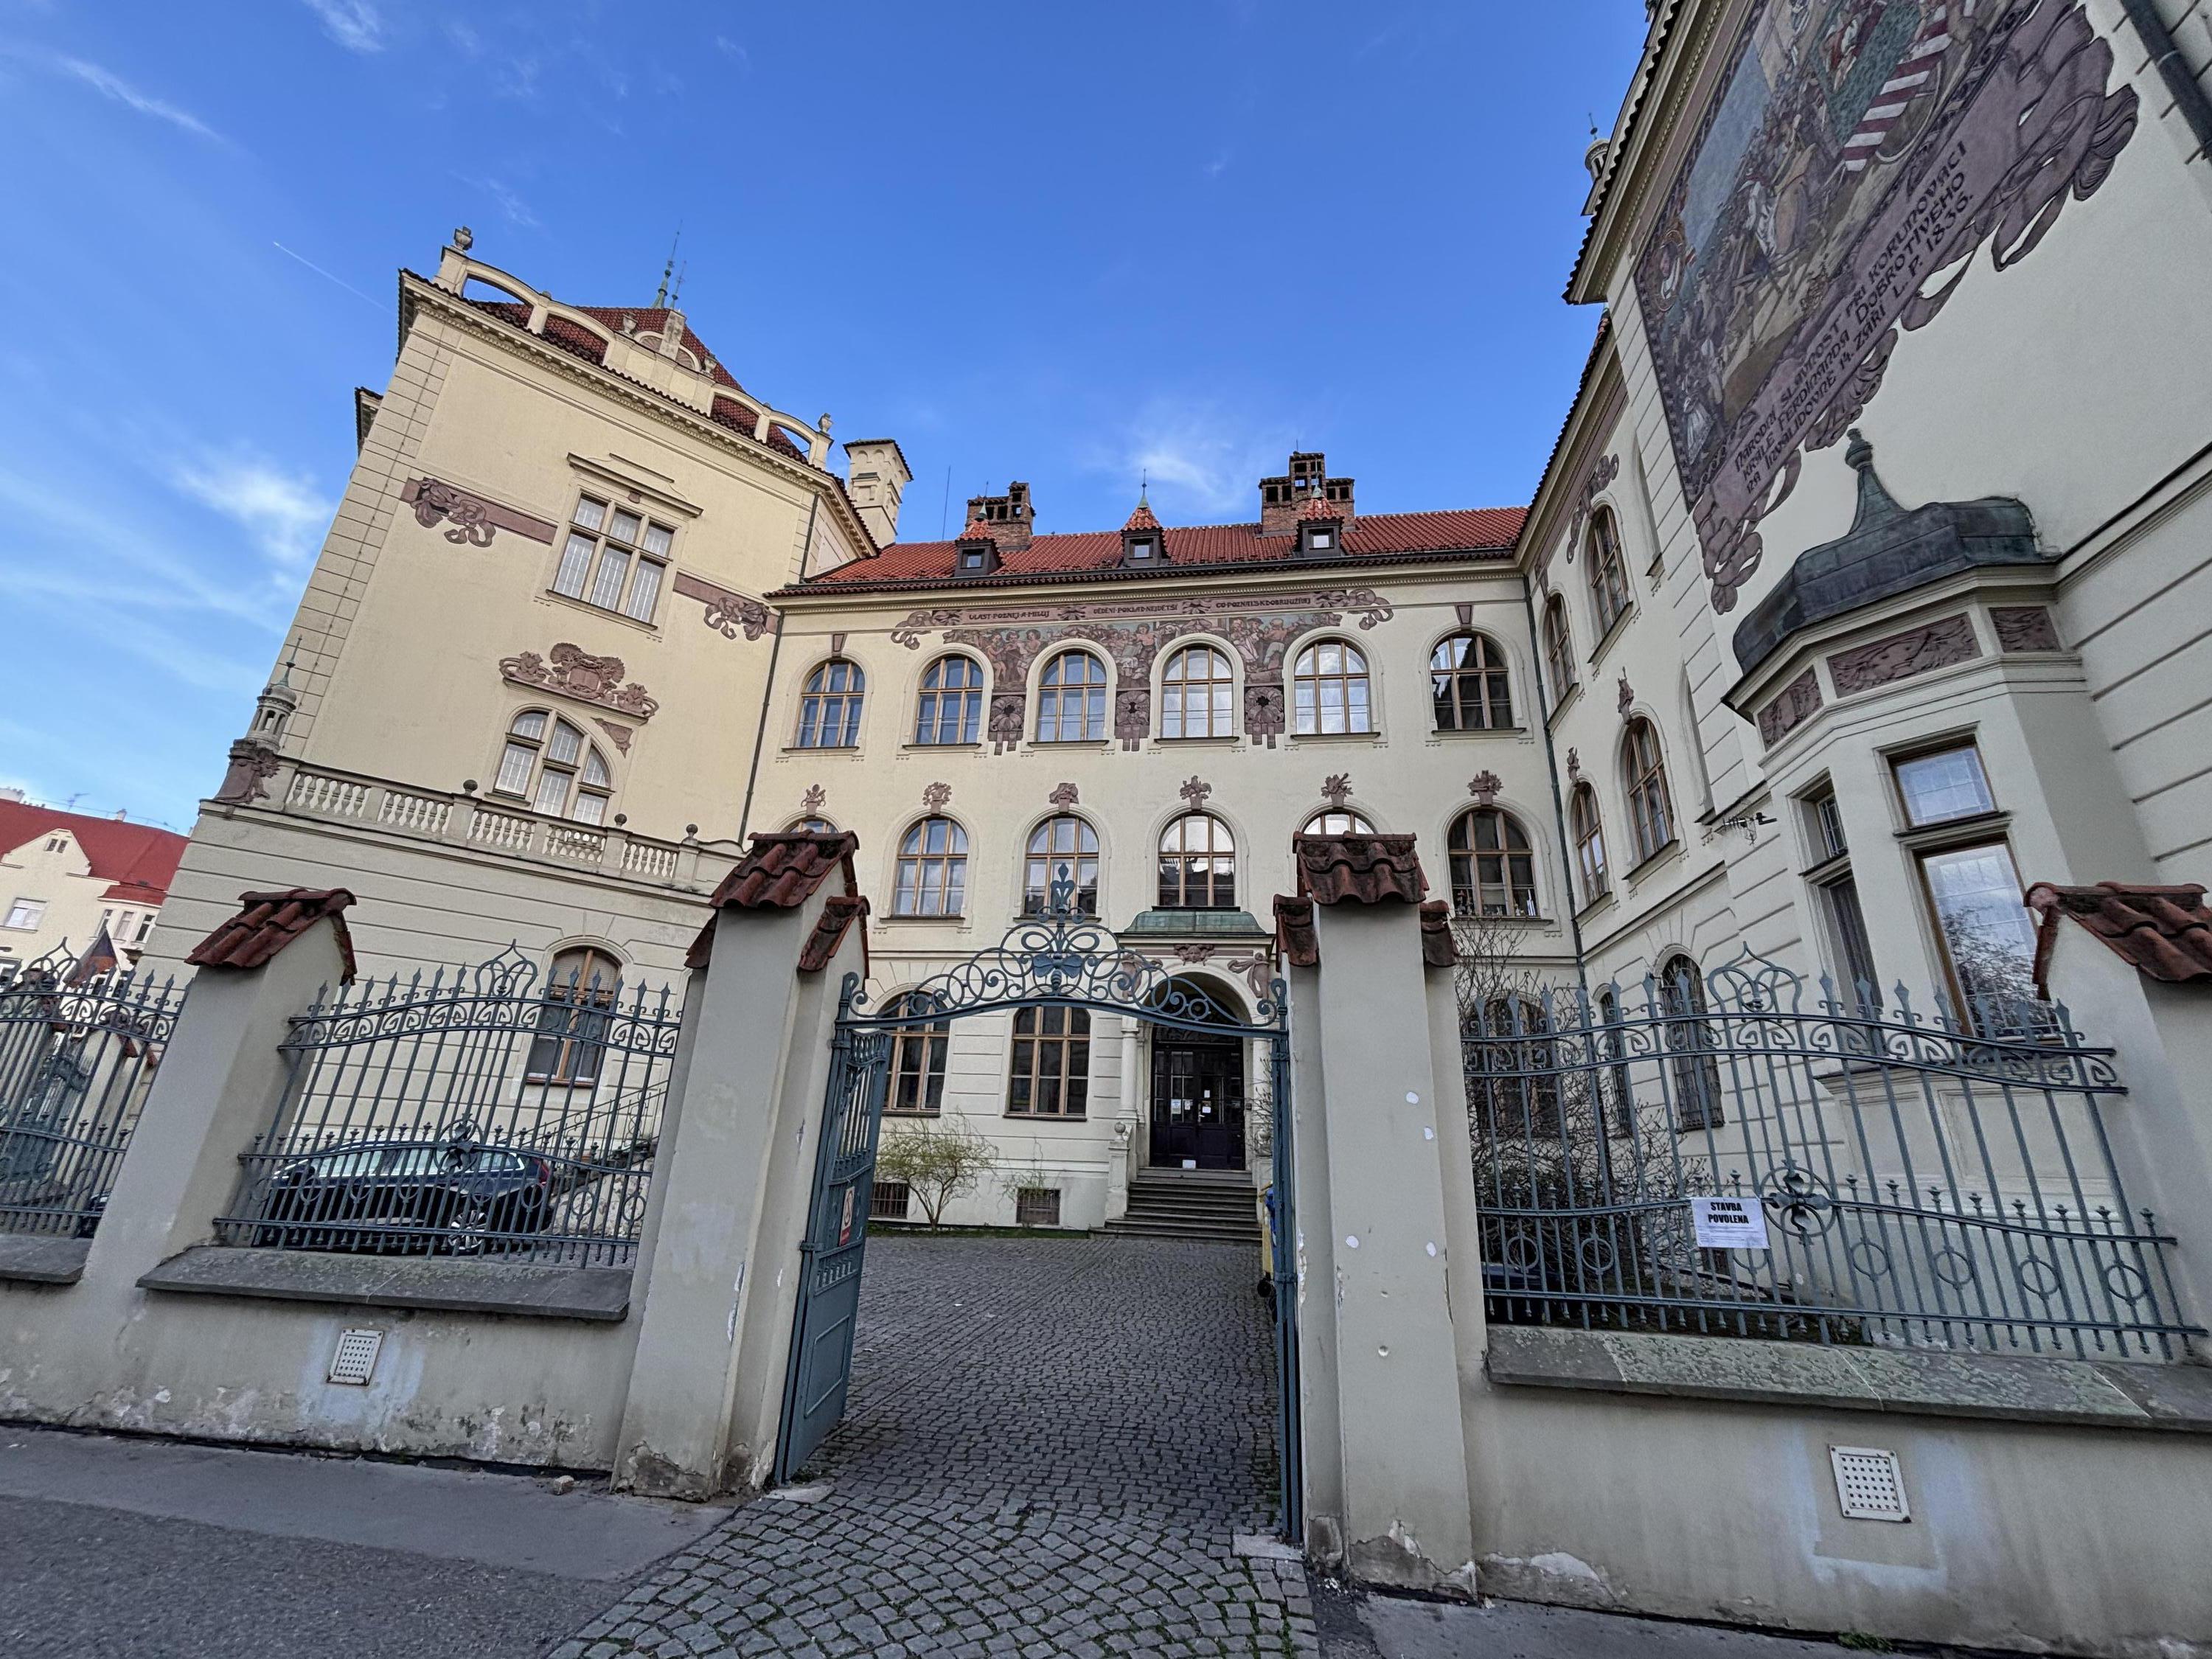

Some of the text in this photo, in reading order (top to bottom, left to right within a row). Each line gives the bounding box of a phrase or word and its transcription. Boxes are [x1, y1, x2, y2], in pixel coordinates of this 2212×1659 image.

[1747, 470, 1761, 494] NA
[1892, 282, 1908, 299] L.
[1908, 254, 1923, 277] P.
[1926, 190, 1974, 252] 1836.
[1778, 330, 1850, 431] FERDINANDA
[1855, 172, 1964, 324] DOBROTIVÉHO
[1780, 313, 1842, 405] SLAVNOST
[1868, 140, 1966, 284] KORUNOVACI
[1708, 1214, 1749, 1224] POVOLENA
[1710, 1202, 1742, 1211] STAVBA
